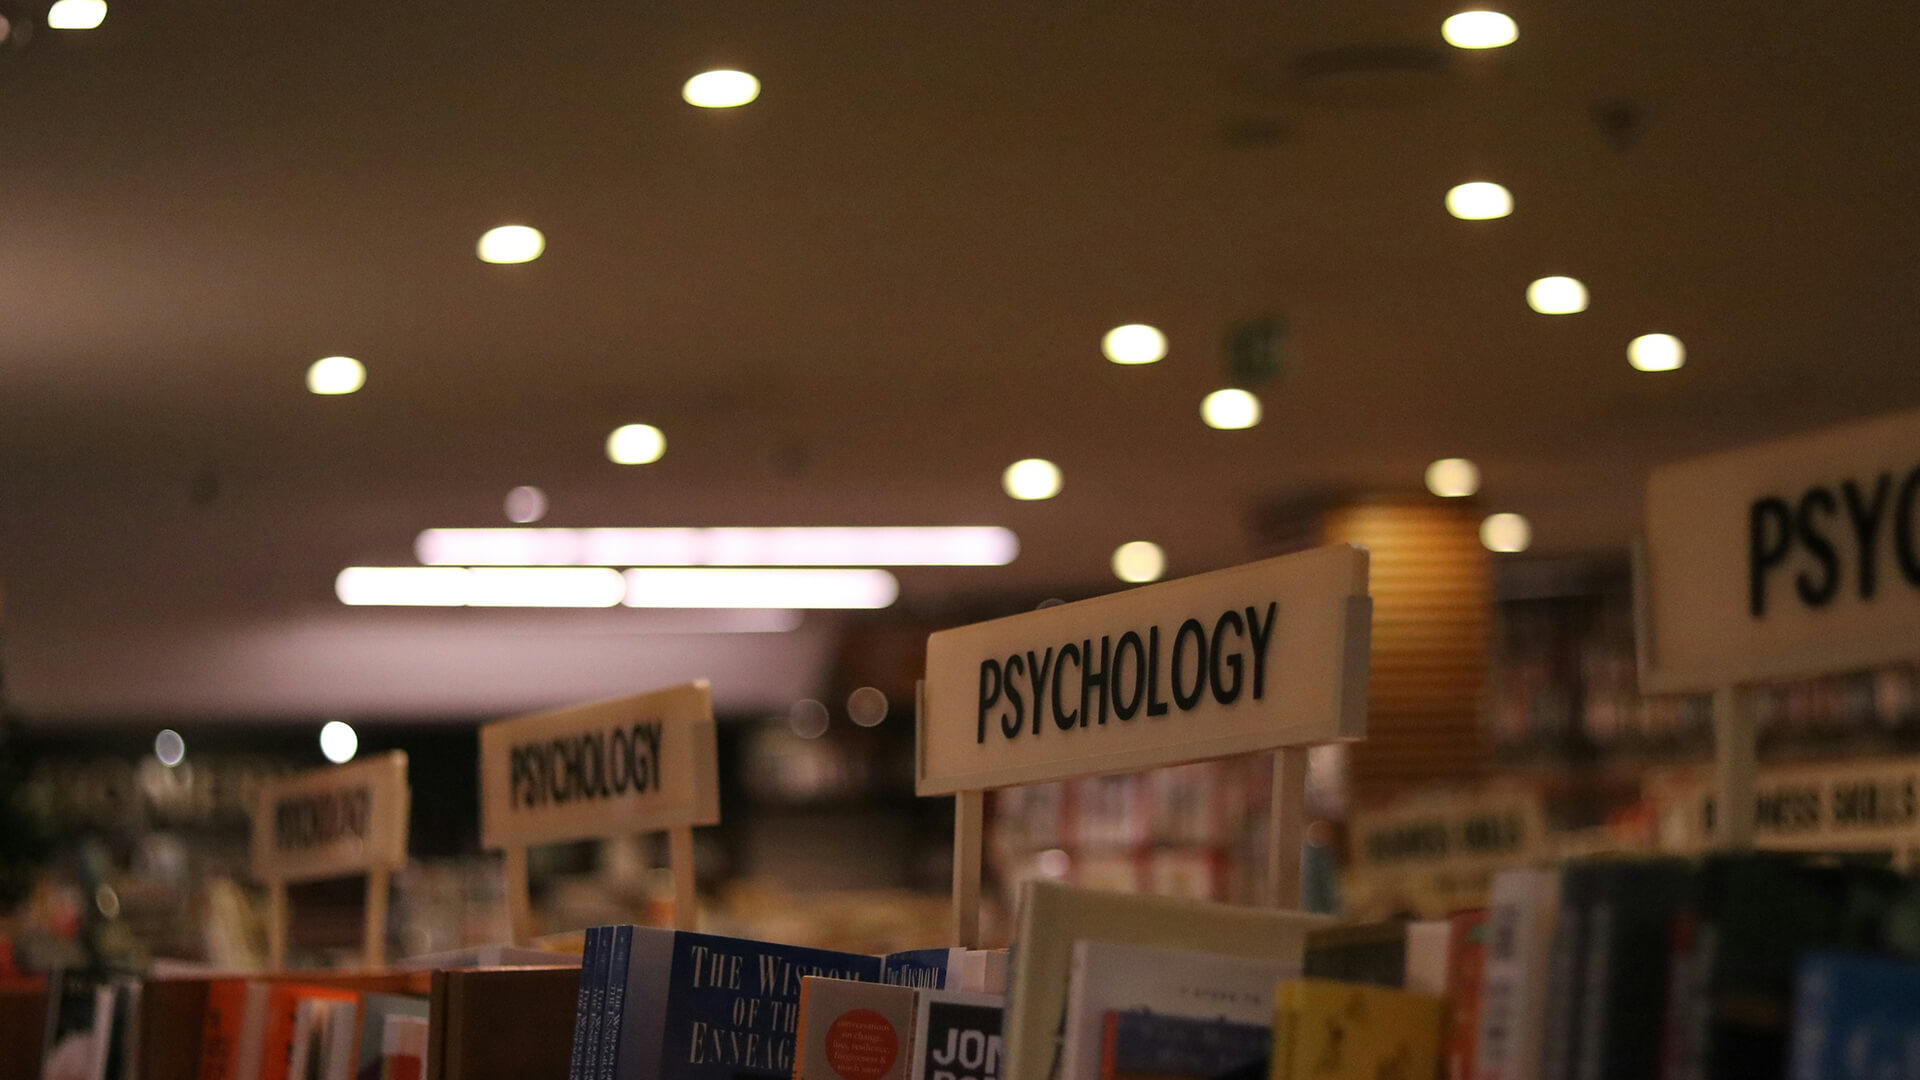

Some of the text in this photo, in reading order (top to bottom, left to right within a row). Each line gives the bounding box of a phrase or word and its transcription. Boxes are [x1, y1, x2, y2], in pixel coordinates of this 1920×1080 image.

[977, 601, 1277, 744] PSYCHOLOGY
[511, 719, 662, 809] PSYCHOLOGY
[691, 945, 743, 990] THE
[733, 996, 760, 1028] OF
